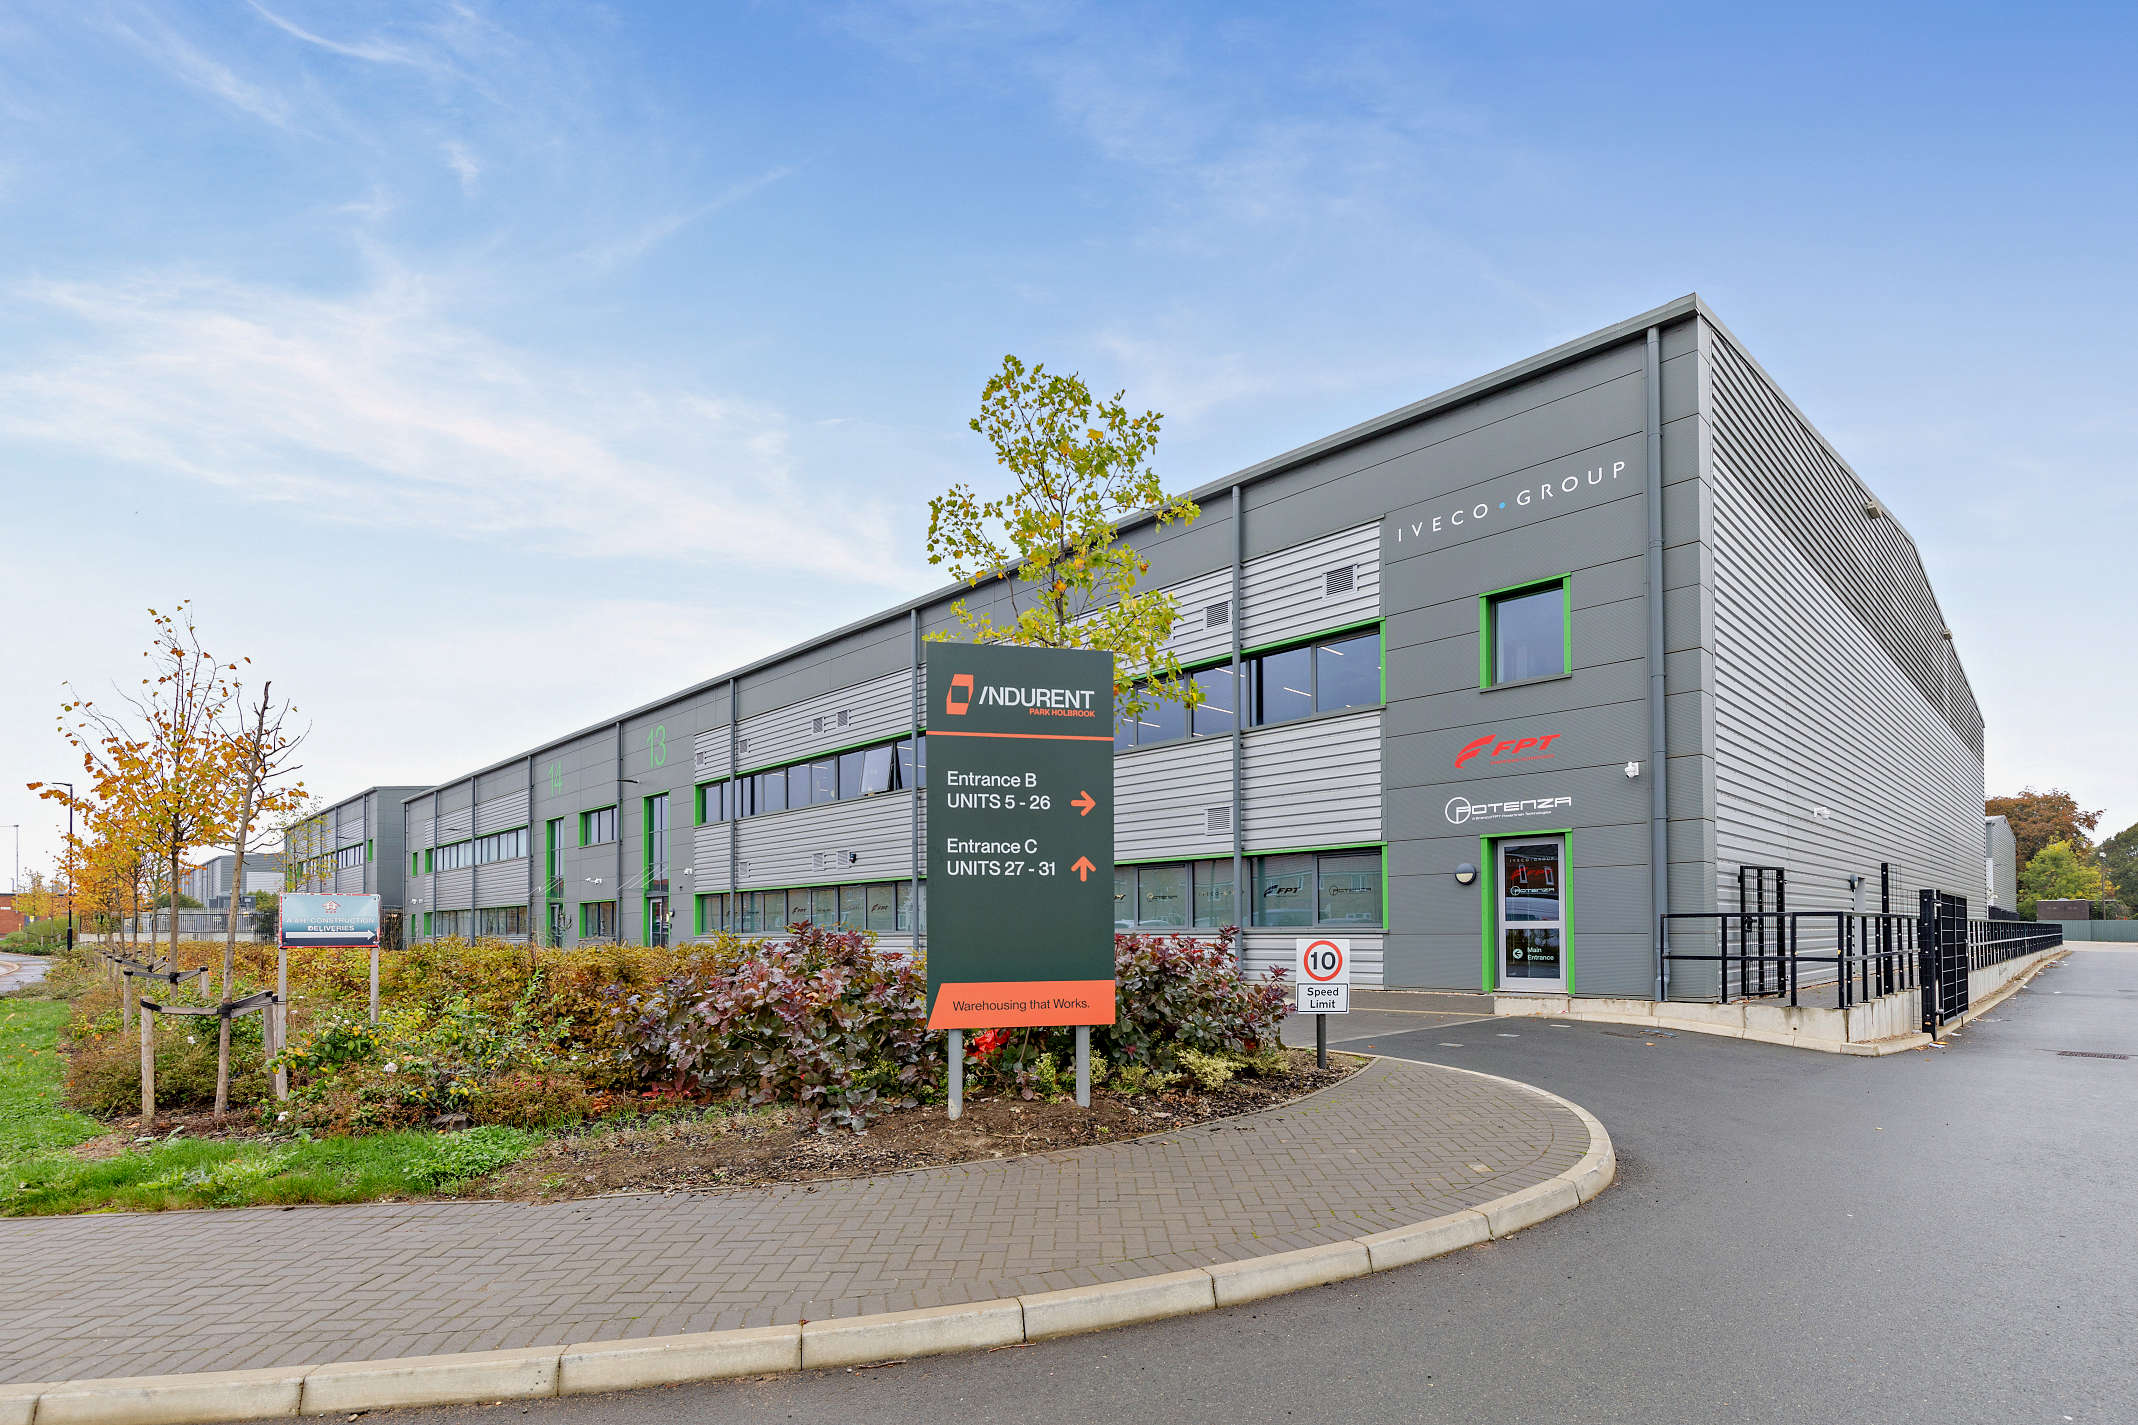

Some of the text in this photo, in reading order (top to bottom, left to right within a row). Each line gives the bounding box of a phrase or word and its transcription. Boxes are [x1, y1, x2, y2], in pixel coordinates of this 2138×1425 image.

[1397, 461, 1625, 543] IVECO GROUP
[1029, 707, 1095, 718] PARK HOLBROOK
[646, 724, 667, 768] 13
[1491, 733, 1561, 757] FPT
[548, 759, 563, 796] 14
[947, 770, 1037, 787] Entrance B
[947, 793, 1001, 809] UNITS
[1005, 795, 1015, 809] 5
[1029, 795, 1051, 810] 26
[1445, 796, 1572, 825] POTENZA
[947, 838, 1038, 854] Entrance C
[947, 861, 1001, 876] UNITS
[1005, 861, 1024, 876] 27
[1038, 862, 1056, 876] 31
[1310, 951, 1336, 971] 10
[1307, 987, 1339, 998] Speed
[952, 998, 1090, 1012] Warehousing that Works.
[1310, 999, 1336, 1009] Limit
